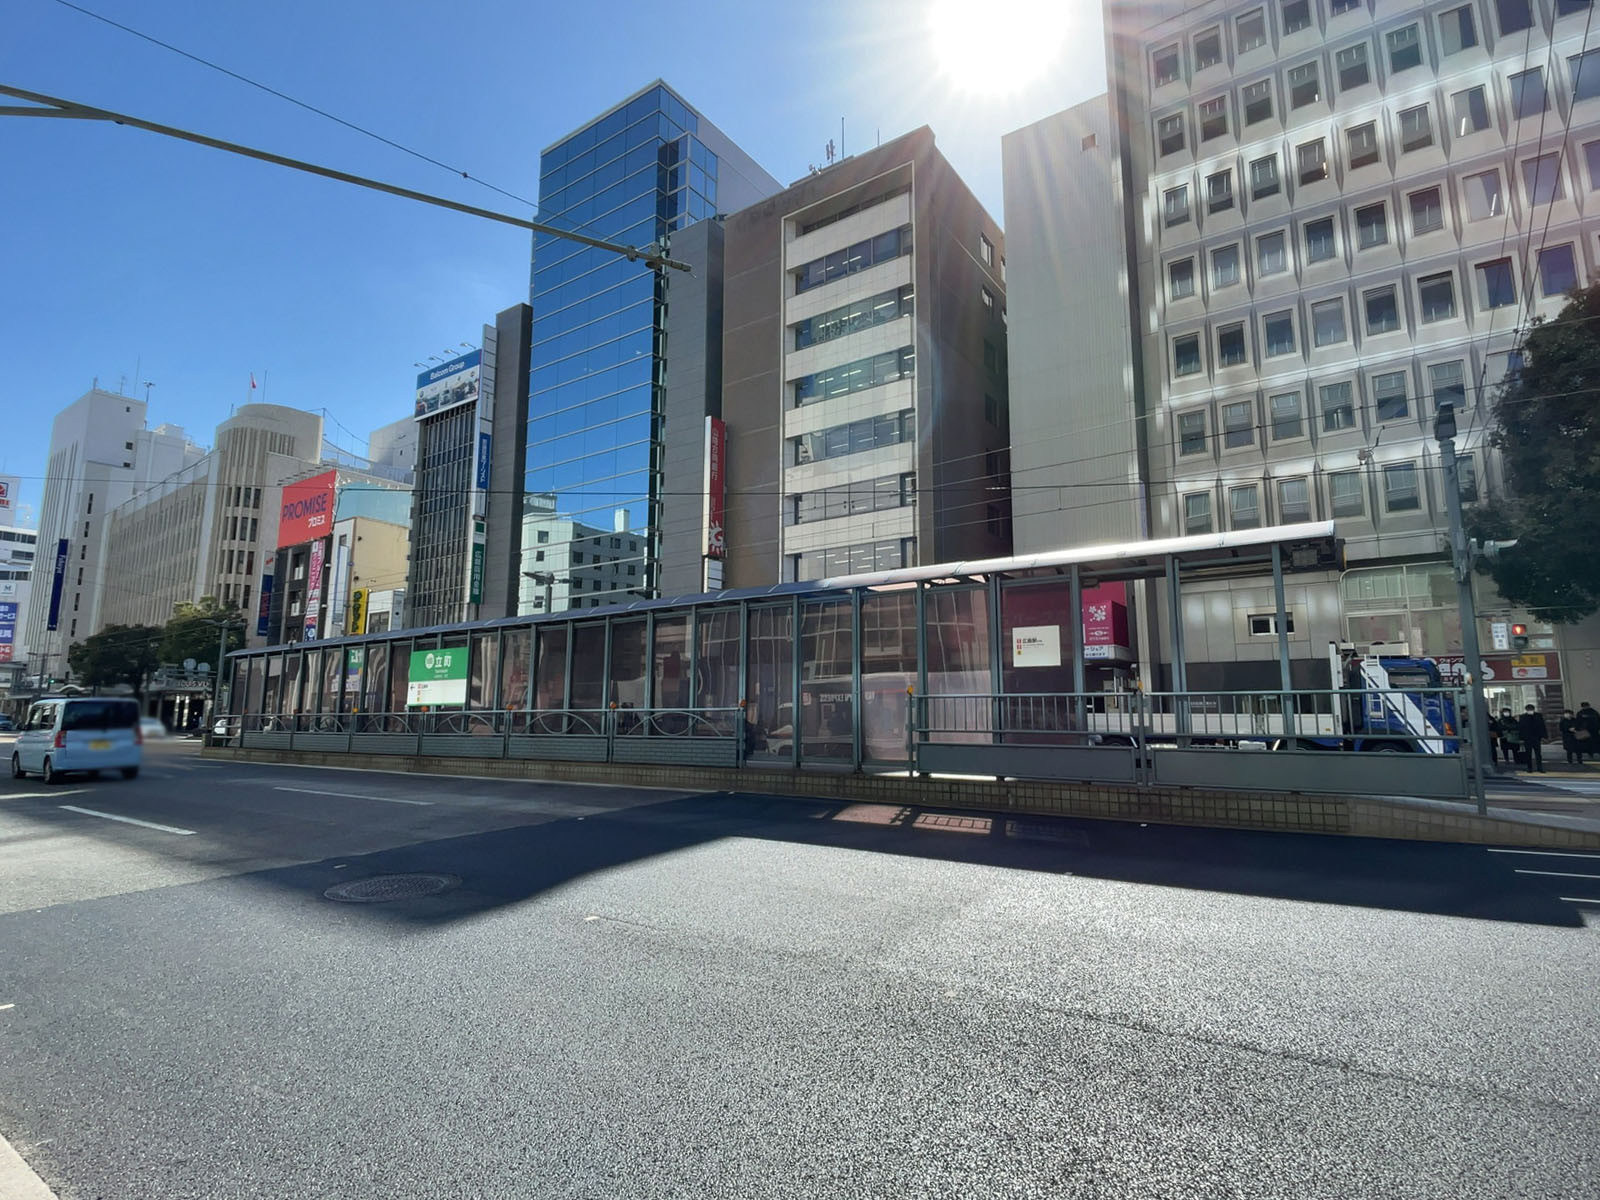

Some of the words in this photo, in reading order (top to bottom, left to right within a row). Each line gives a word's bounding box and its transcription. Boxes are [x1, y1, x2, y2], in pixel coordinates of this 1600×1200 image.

[449, 362, 464, 373] Group
[282, 493, 328, 522] PROMISE
[308, 514, 326, 528] プロミス
[435, 656, 452, 668] 立町
